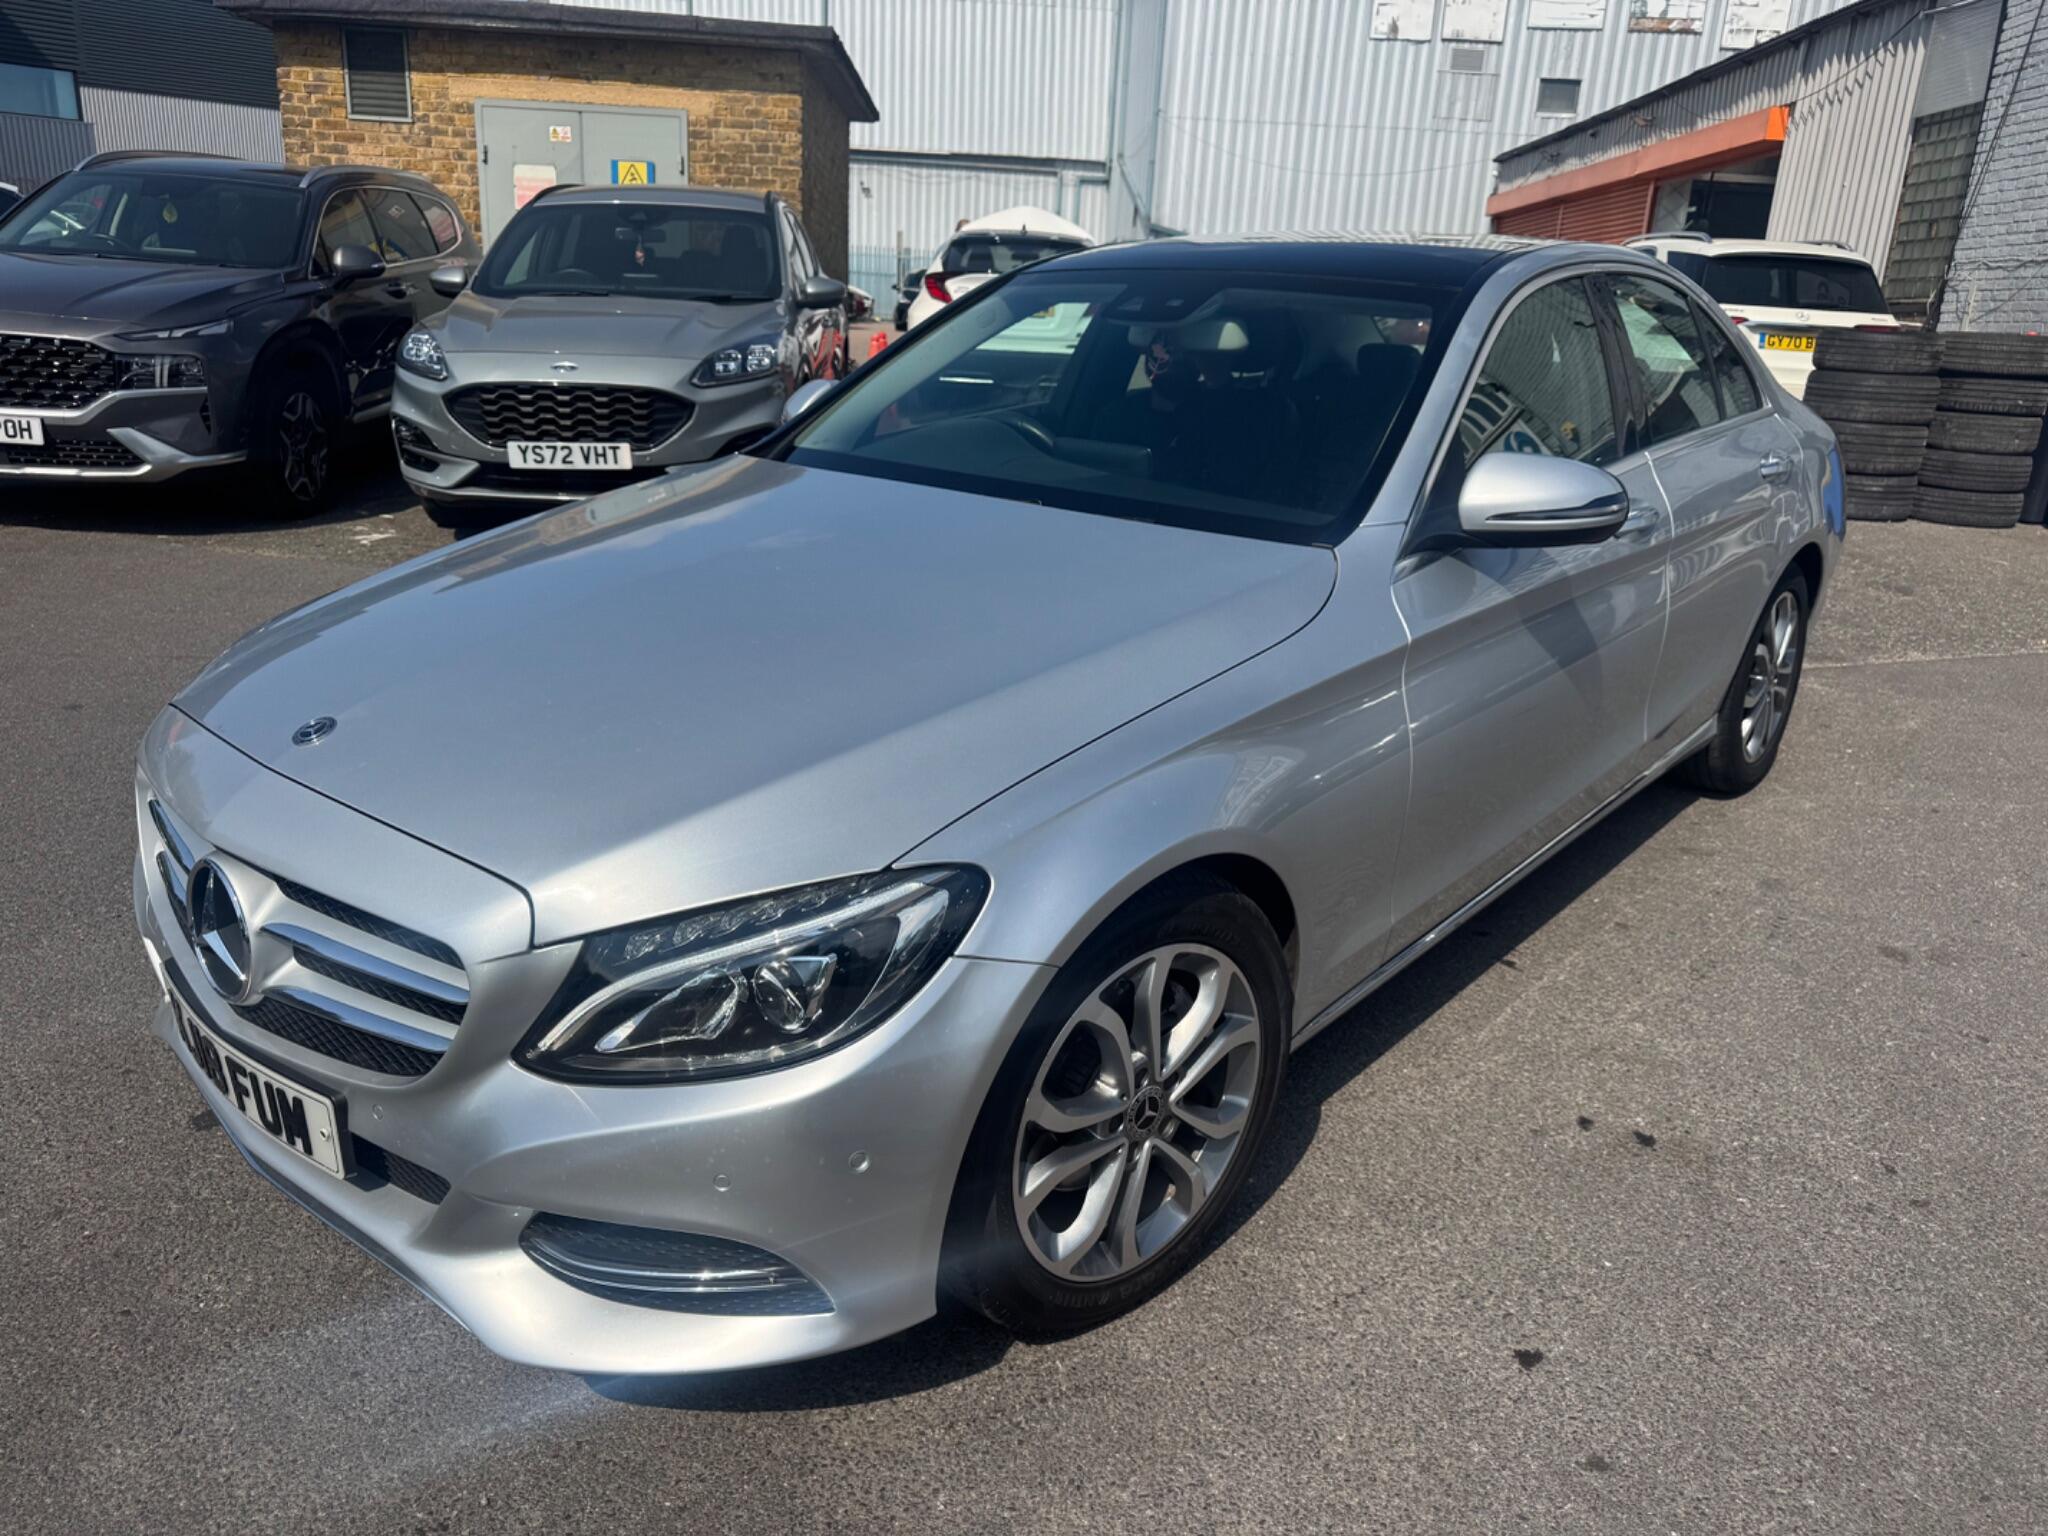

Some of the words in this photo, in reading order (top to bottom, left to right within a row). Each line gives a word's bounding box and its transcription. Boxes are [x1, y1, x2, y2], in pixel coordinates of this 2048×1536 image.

[0, 418, 33, 440] OH
[517, 444, 575, 465] YS72
[579, 445, 621, 465] VHT
[225, 1055, 313, 1156] FUM
